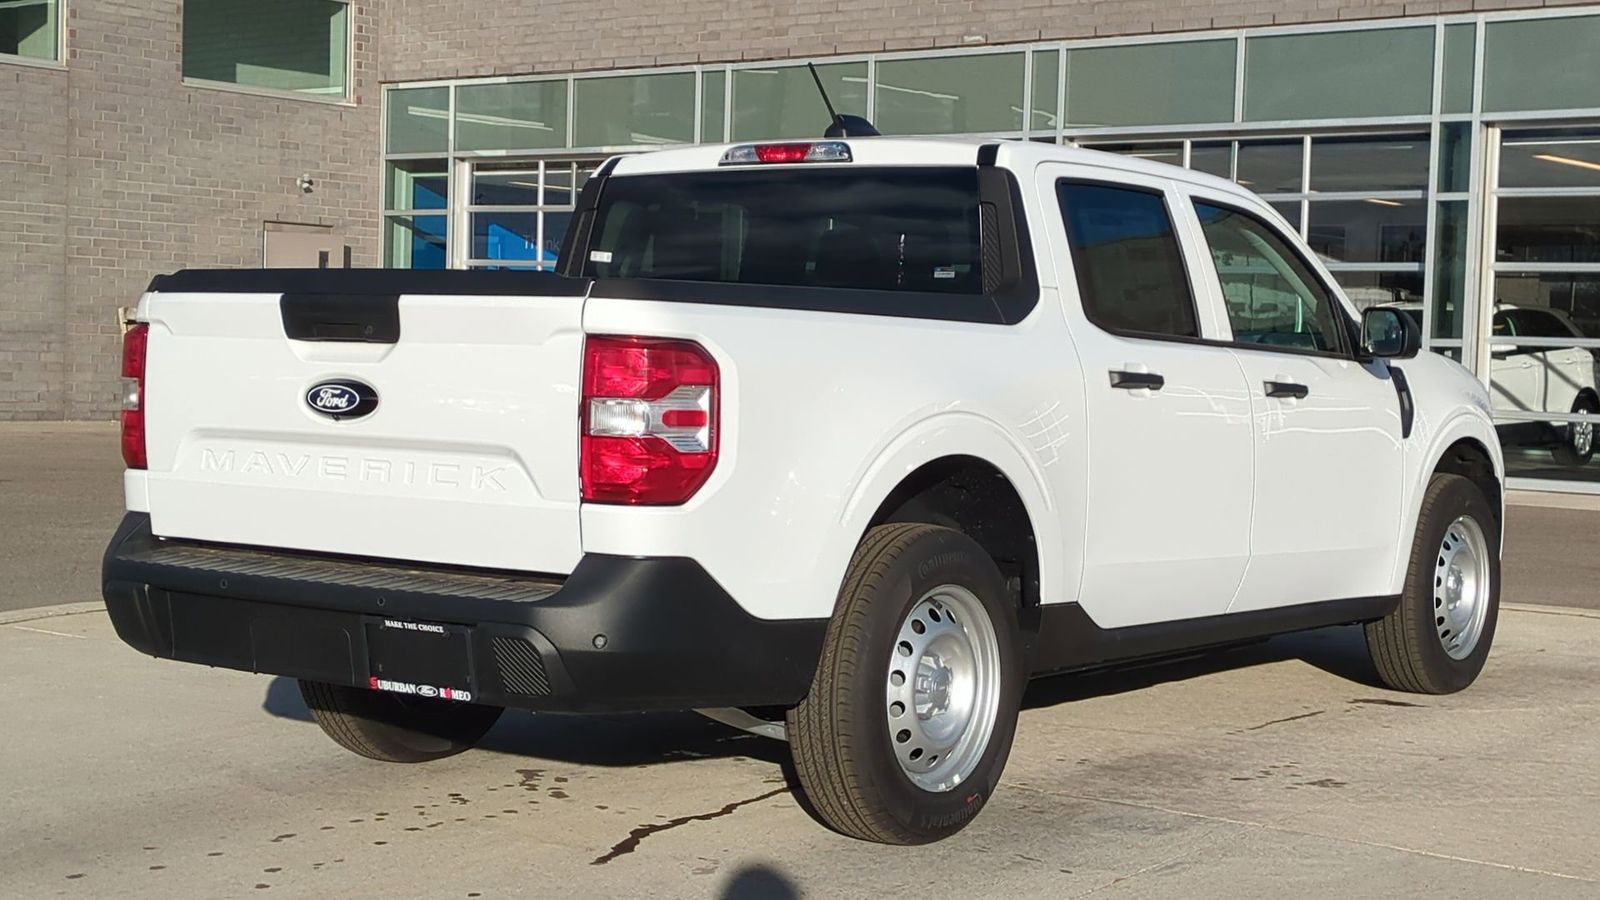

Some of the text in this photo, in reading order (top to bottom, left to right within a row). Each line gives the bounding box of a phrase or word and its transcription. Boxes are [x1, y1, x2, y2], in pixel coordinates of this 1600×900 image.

[523, 233, 561, 252] Thnk
[315, 386, 350, 409] Ford
[200, 448, 507, 491] MAVERICK
[384, 619, 445, 633] MAKE THE CHOICE
[369, 676, 416, 694] SUBURBAN
